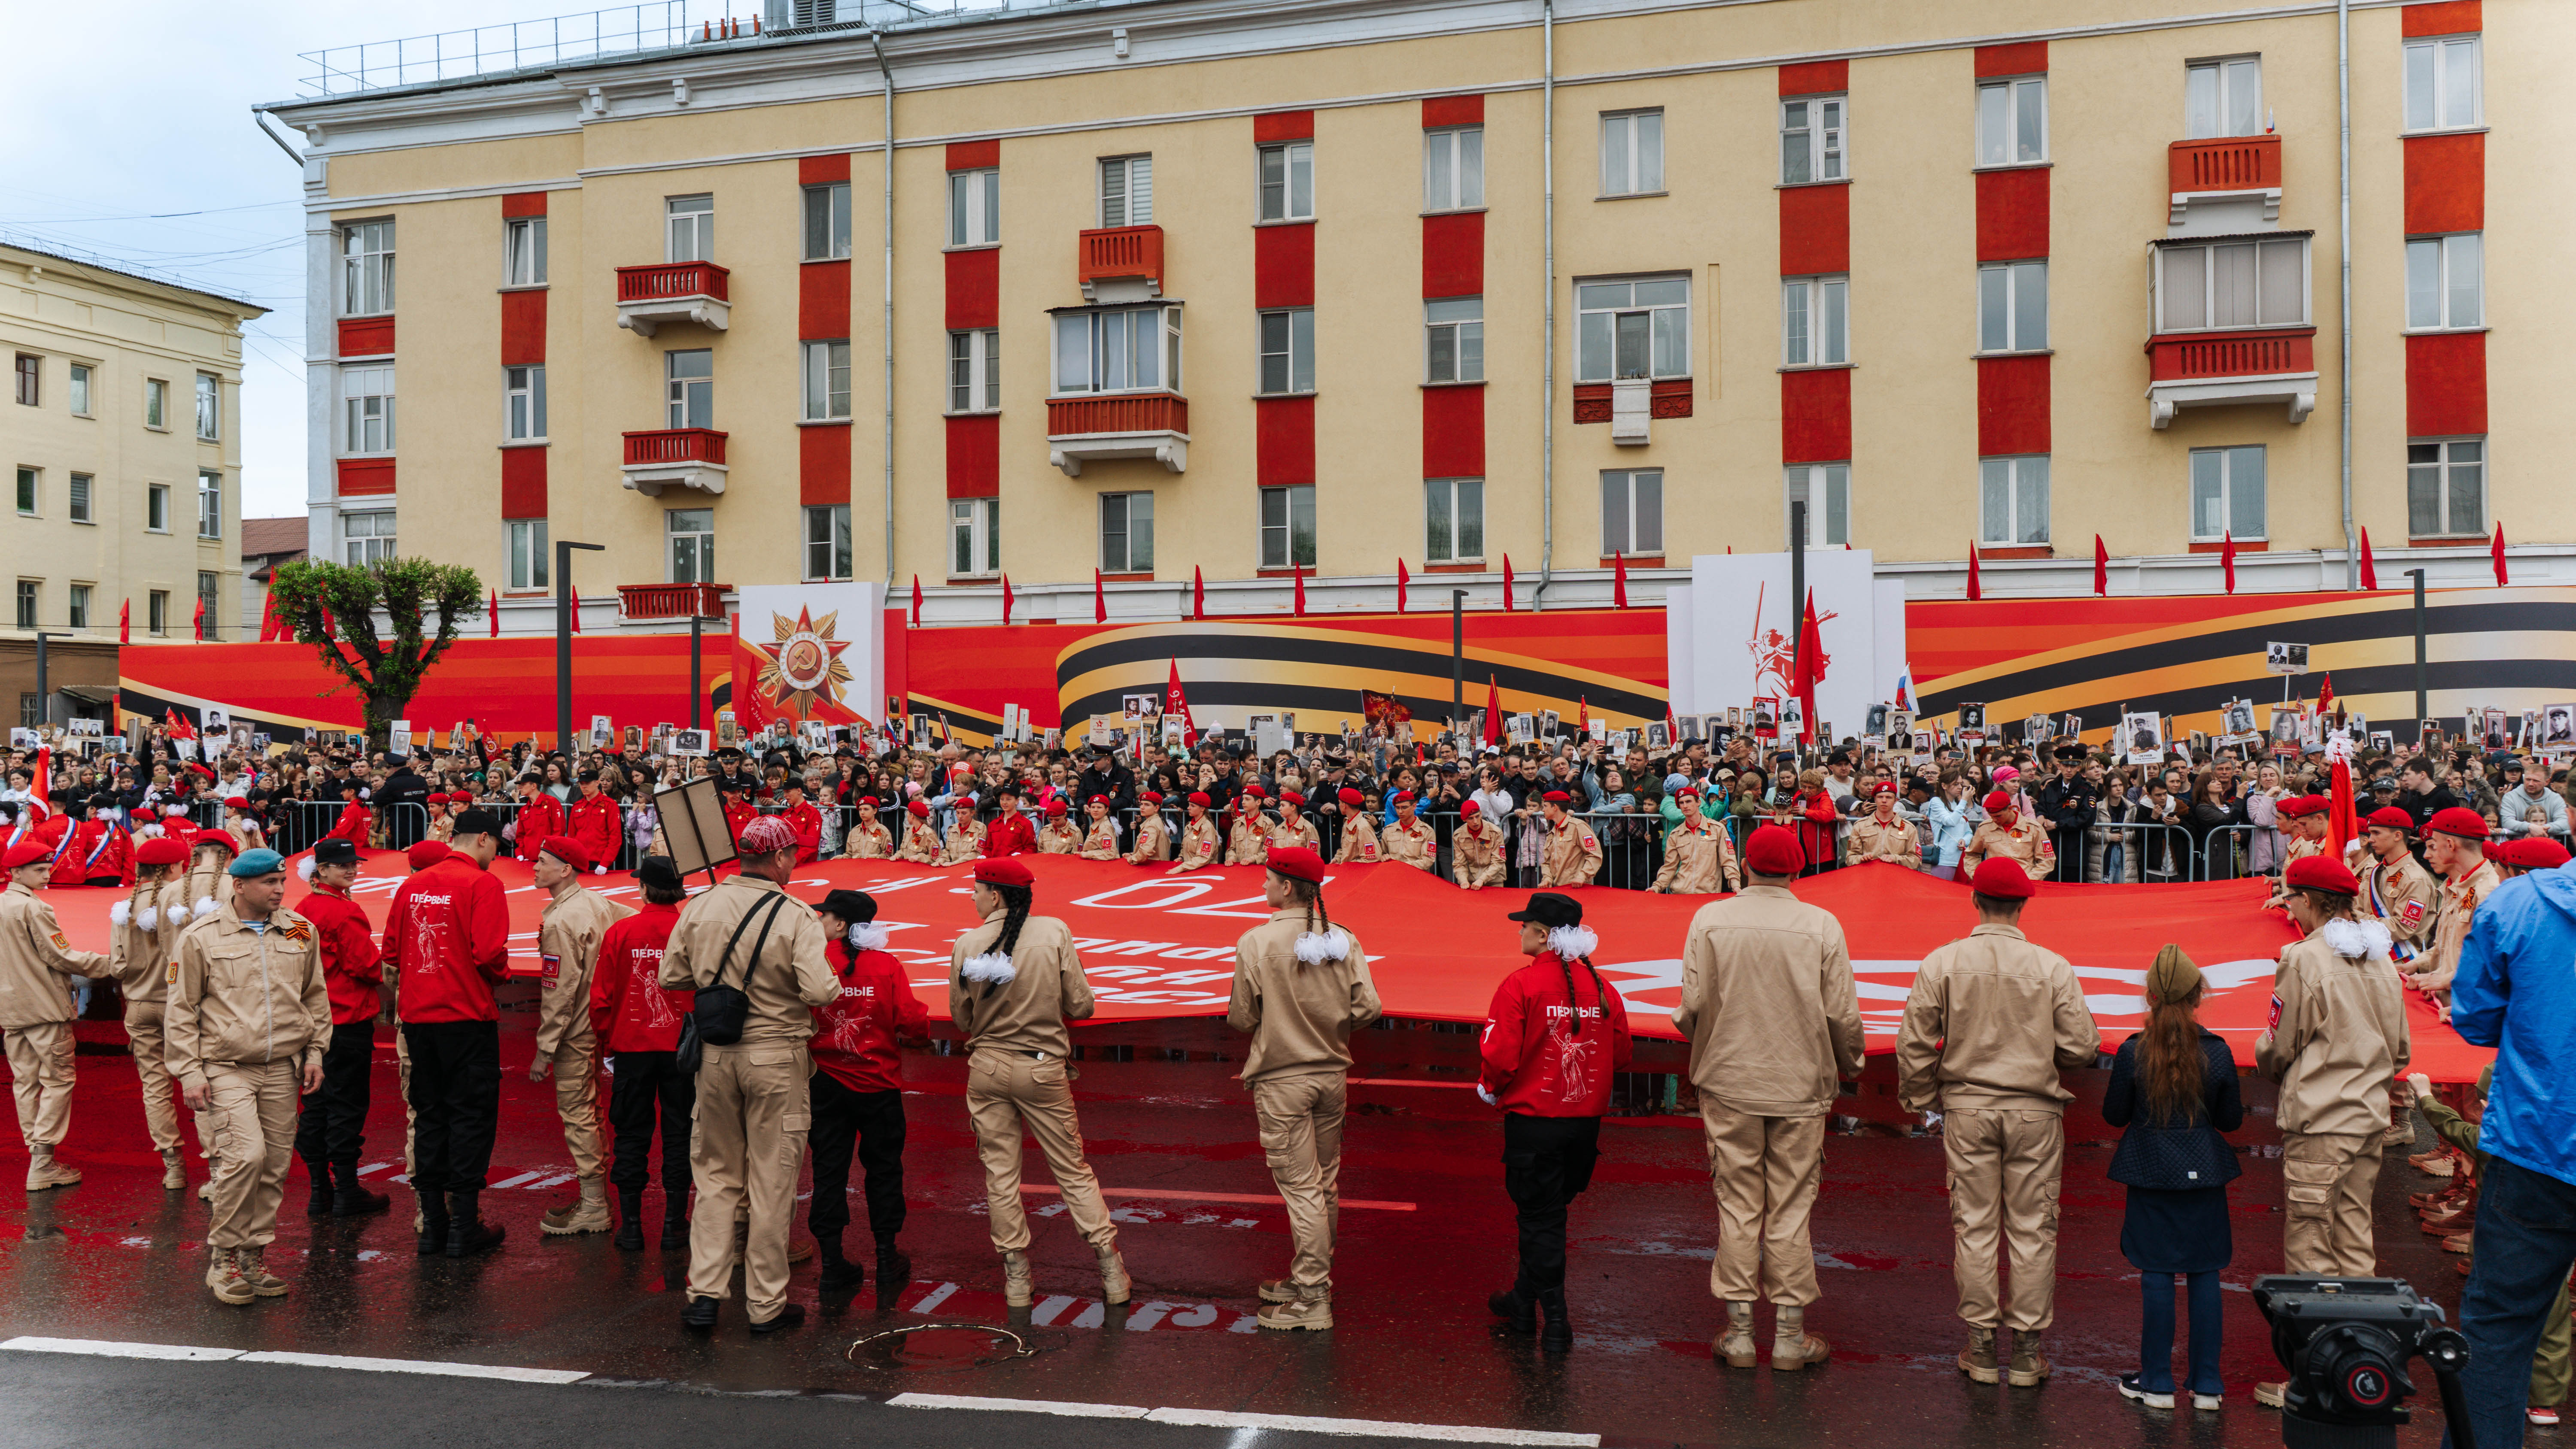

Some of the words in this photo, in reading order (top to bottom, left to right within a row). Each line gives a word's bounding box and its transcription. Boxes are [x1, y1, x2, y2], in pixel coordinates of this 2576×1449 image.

[410, 893, 452, 905] ПЕРВЫЕ
[632, 949, 666, 959] ПЕРВ
[840, 986, 875, 997] ВЫЕ
